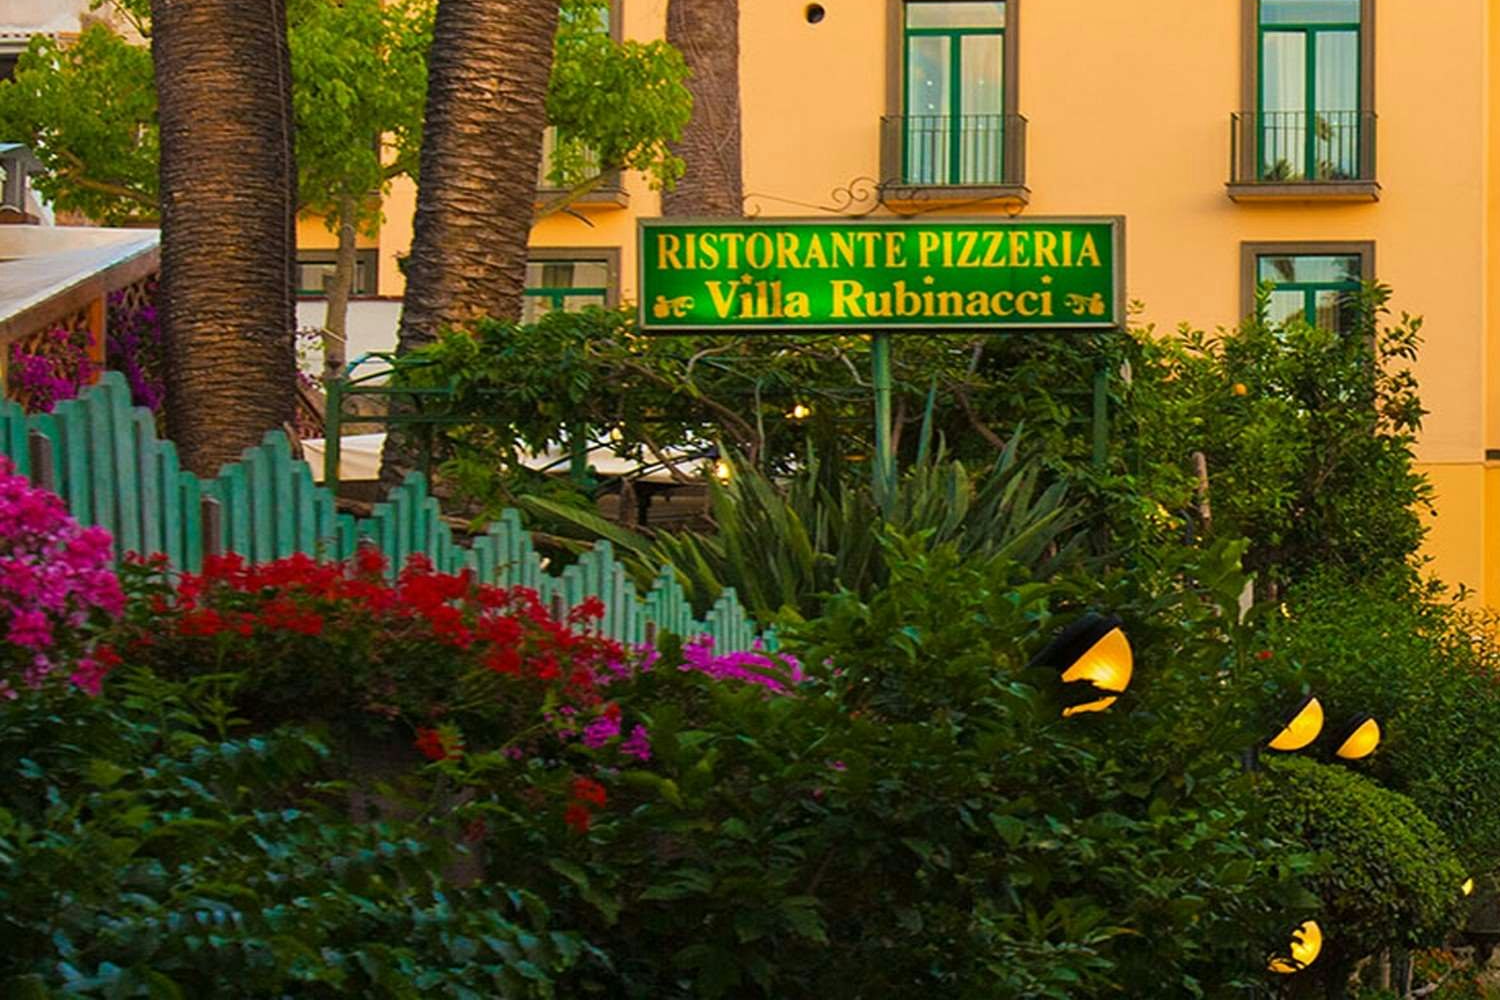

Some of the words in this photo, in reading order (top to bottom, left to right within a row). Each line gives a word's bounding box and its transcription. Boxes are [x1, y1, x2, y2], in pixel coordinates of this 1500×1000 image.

[658, 231, 906, 270] RISTORANTE
[918, 231, 1101, 268] PIZZERIA
[706, 274, 811, 319] Villa
[831, 276, 1053, 318] Rubinacci
